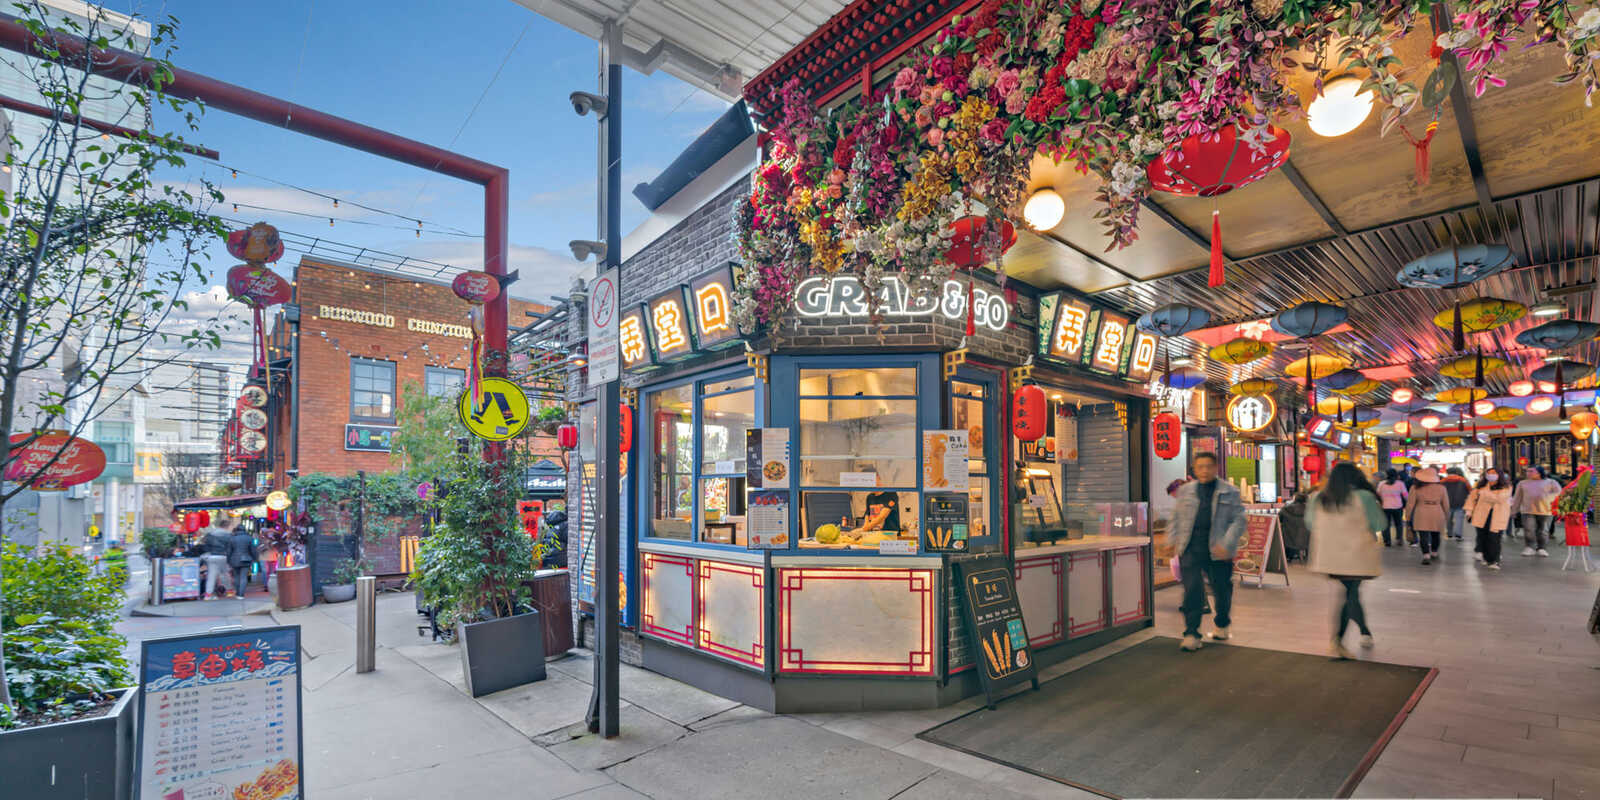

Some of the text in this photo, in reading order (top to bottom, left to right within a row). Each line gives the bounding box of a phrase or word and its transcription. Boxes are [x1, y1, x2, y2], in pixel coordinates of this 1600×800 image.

[319, 304, 485, 341] BURWOOD CHINATOW
[620, 281, 730, 364] 弄堂口
[1056, 303, 1157, 374] 弄堂口
[27, 441, 80, 458] Montly
[24, 463, 85, 477] Fetival
